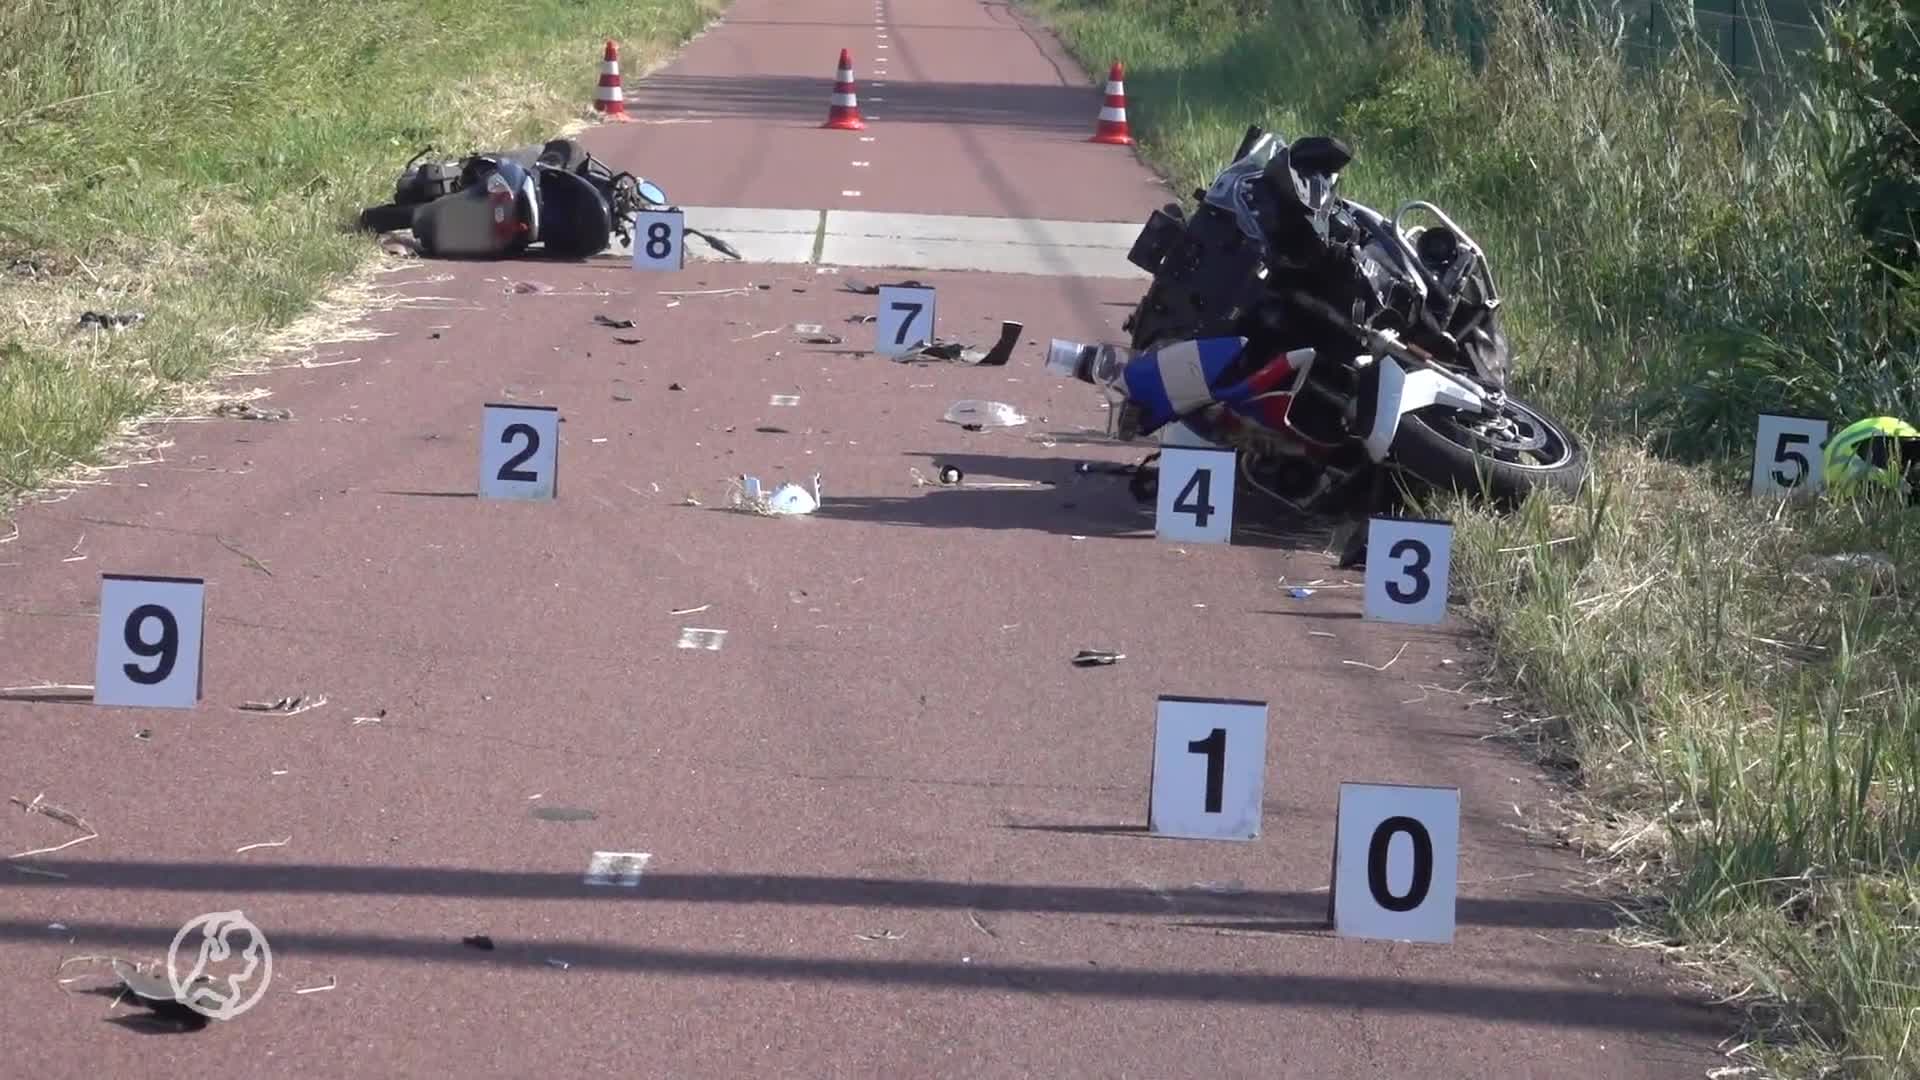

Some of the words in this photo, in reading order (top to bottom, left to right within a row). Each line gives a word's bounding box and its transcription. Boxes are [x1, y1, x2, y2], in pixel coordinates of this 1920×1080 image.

[646, 222, 672, 260] 8
[891, 302, 924, 345] 7
[497, 423, 540, 483] 2
[1772, 432, 1810, 488] 5
[1172, 467, 1216, 528] 4
[1384, 538, 1432, 605] 3
[123, 603, 179, 685] 9
[1187, 727, 1227, 814] 1
[1367, 815, 1434, 913] 0
